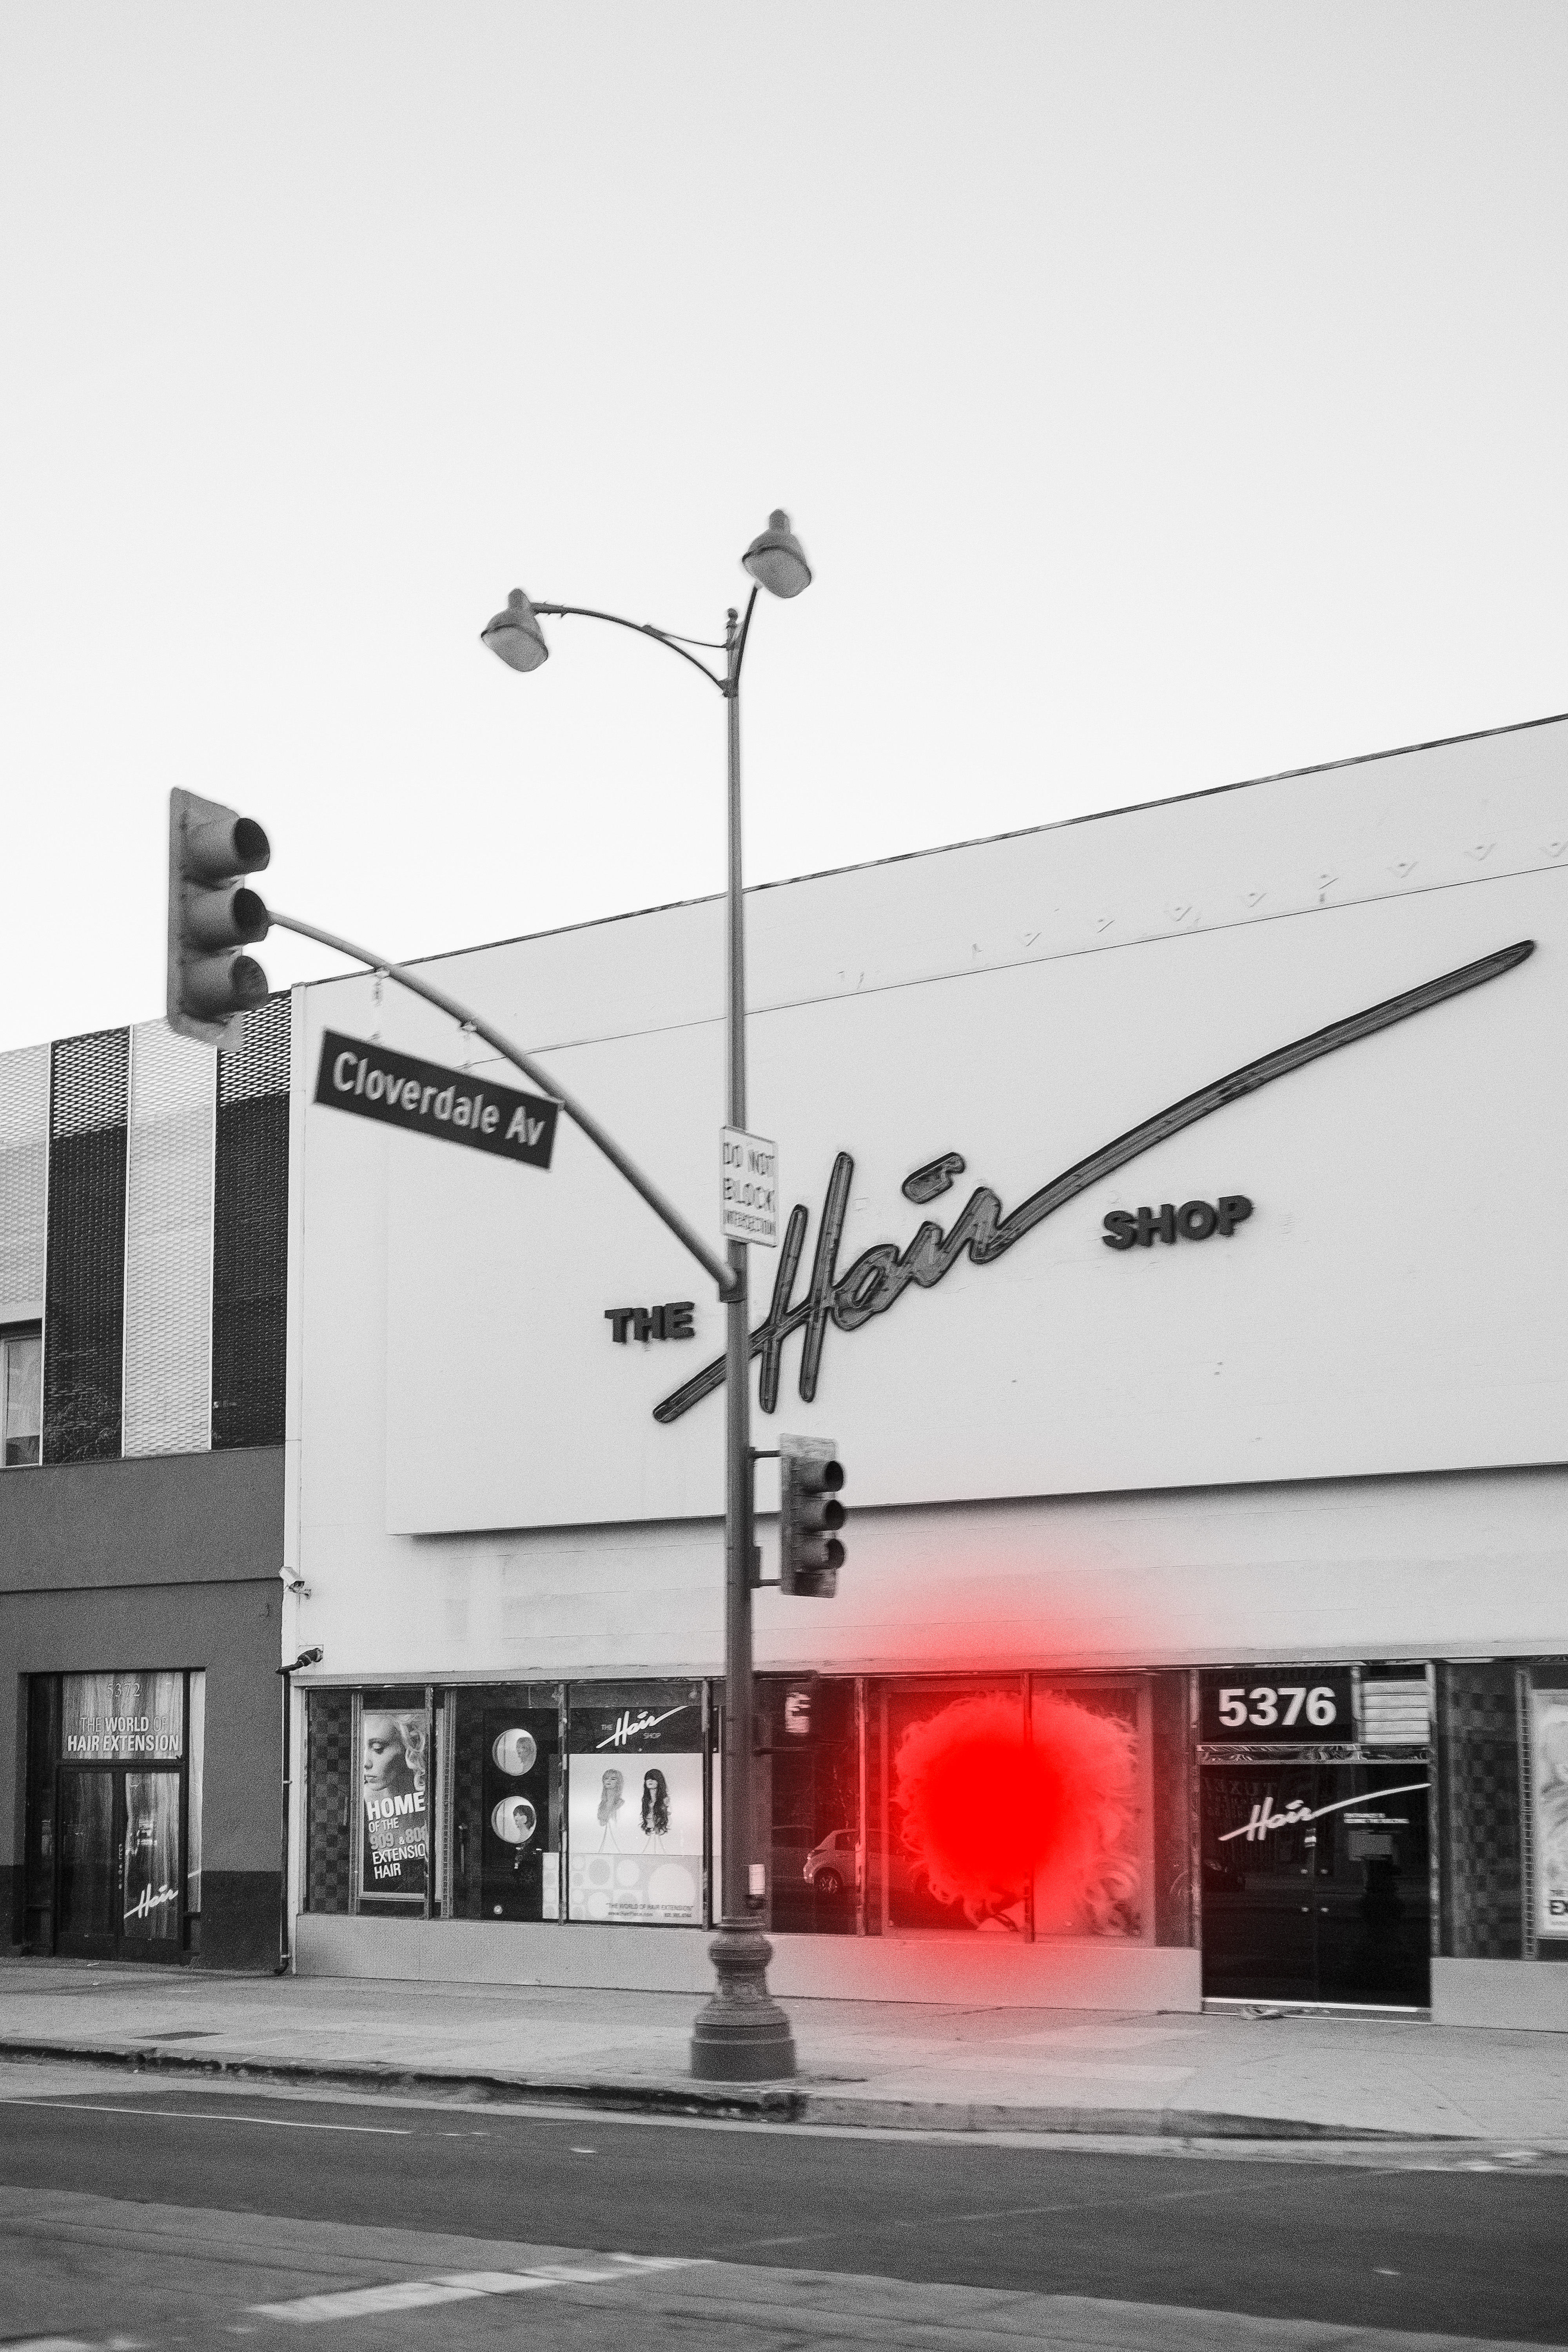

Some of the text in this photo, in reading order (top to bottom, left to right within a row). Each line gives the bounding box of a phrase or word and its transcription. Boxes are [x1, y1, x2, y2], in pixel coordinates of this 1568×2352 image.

[332, 1051, 545, 1147] Cloverdale Av
[723, 1142, 775, 1177] DO NOT
[653, 940, 1536, 1423] Hair
[723, 1177, 775, 1213] BLOCK
[1102, 1195, 1254, 1250] SHOP
[604, 1301, 695, 1343] THE
[107, 1683, 141, 1697] 5372
[1218, 1687, 1338, 1726] 5376
[80, 1716, 168, 1732] THE WORLD OF
[595, 1705, 689, 1749] Hair
[67, 1735, 179, 1751] HAIR EXTENSION
[366, 1791, 426, 1821] HOME
[1218, 1782, 1432, 1842] Hair
[368, 1817, 399, 1833] OF THE
[370, 1832, 394, 1850] 909
[399, 1836, 405, 1845] &
[374, 1862, 402, 1880] HAIR
[124, 1882, 179, 1919] Hair
